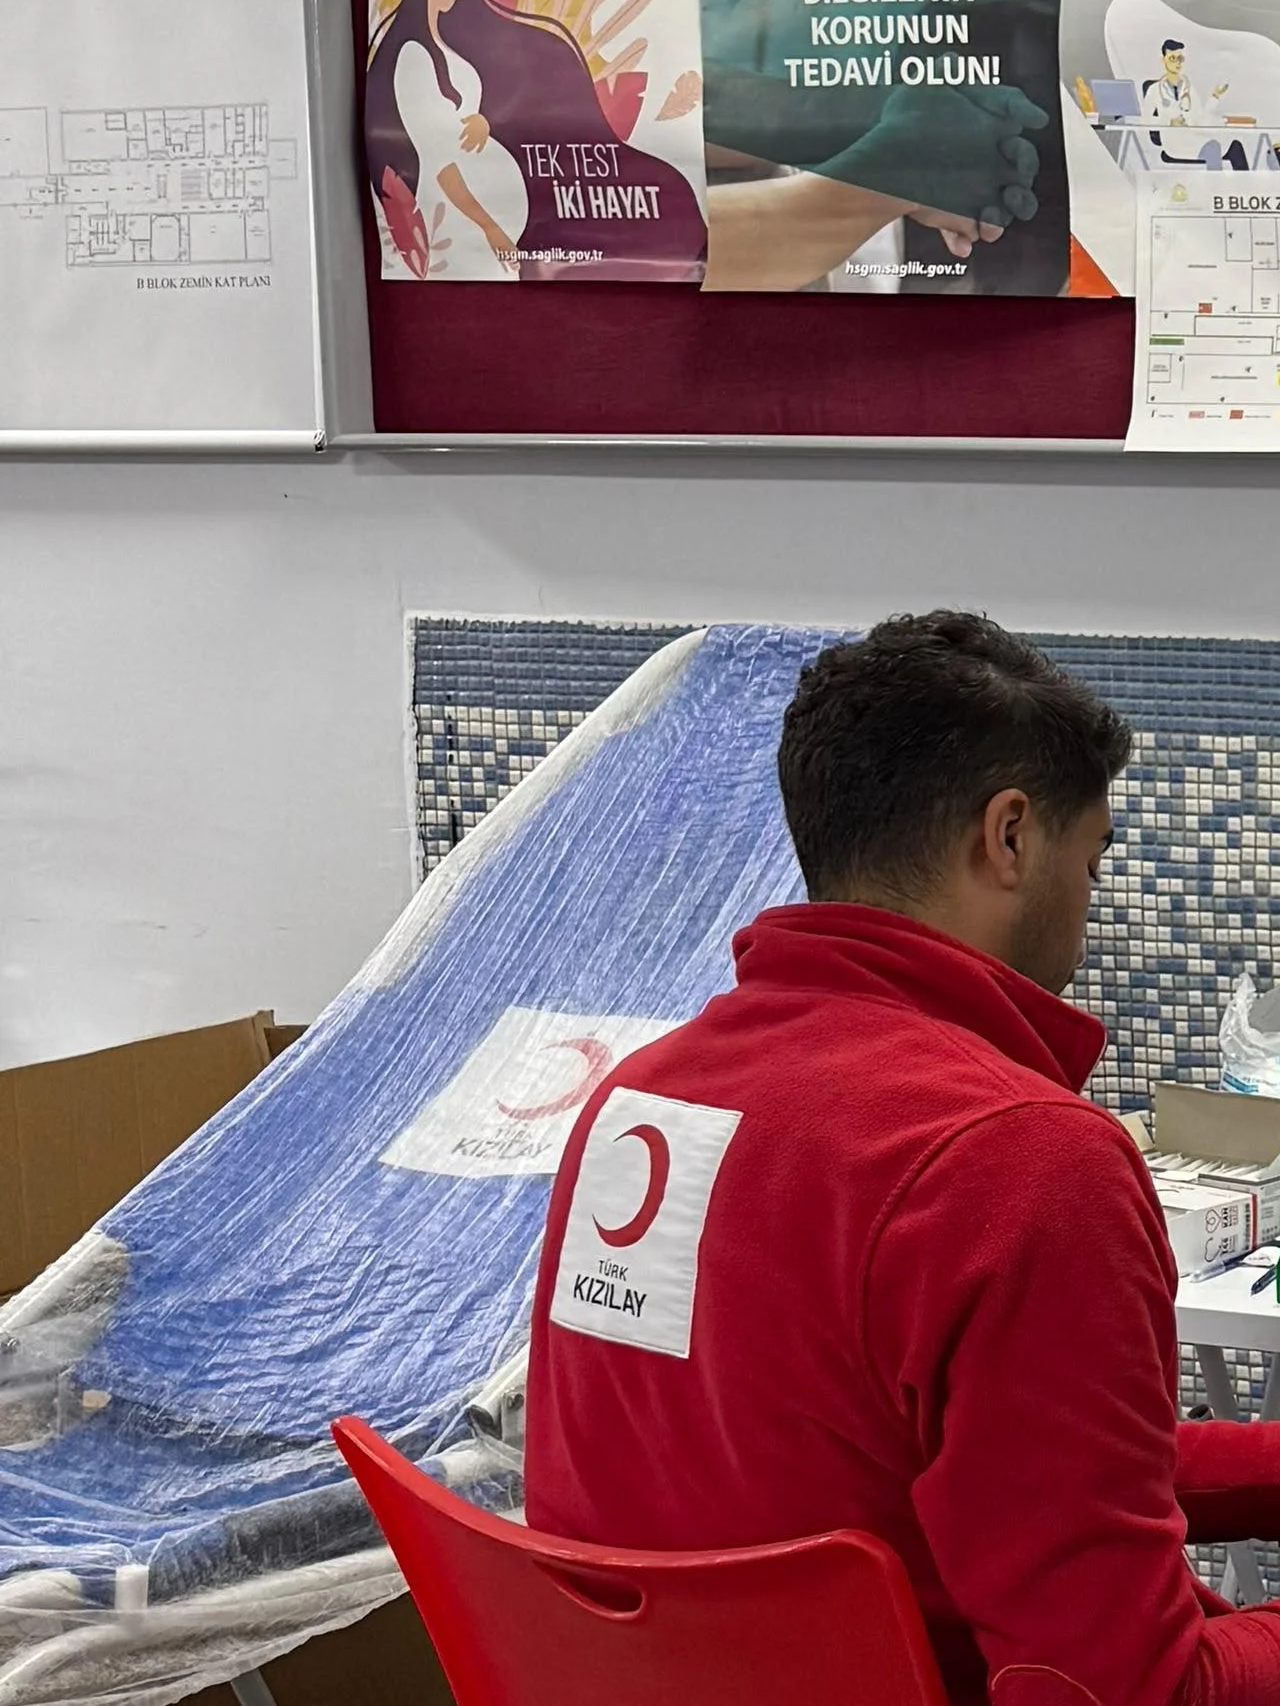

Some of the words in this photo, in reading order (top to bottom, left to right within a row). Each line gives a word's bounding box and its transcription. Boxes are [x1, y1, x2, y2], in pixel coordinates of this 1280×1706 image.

[811, 14, 968, 46] KORUNUN
[784, 50, 893, 87] TEDAVİ
[900, 55, 1000, 85] OLUN!
[521, 144, 565, 178] TEK
[567, 144, 619, 178] TEST
[553, 180, 586, 220] İKİ
[591, 186, 660, 220] HAYAT
[1213, 197, 1224, 210] B
[1229, 196, 1272, 210] BLOK
[215, 276, 237, 288] KAT
[844, 259, 967, 278] hsgm.saglik.gov.tr
[598, 1259, 629, 1282] TÜRK
[573, 1274, 647, 1318] KIZILAY
